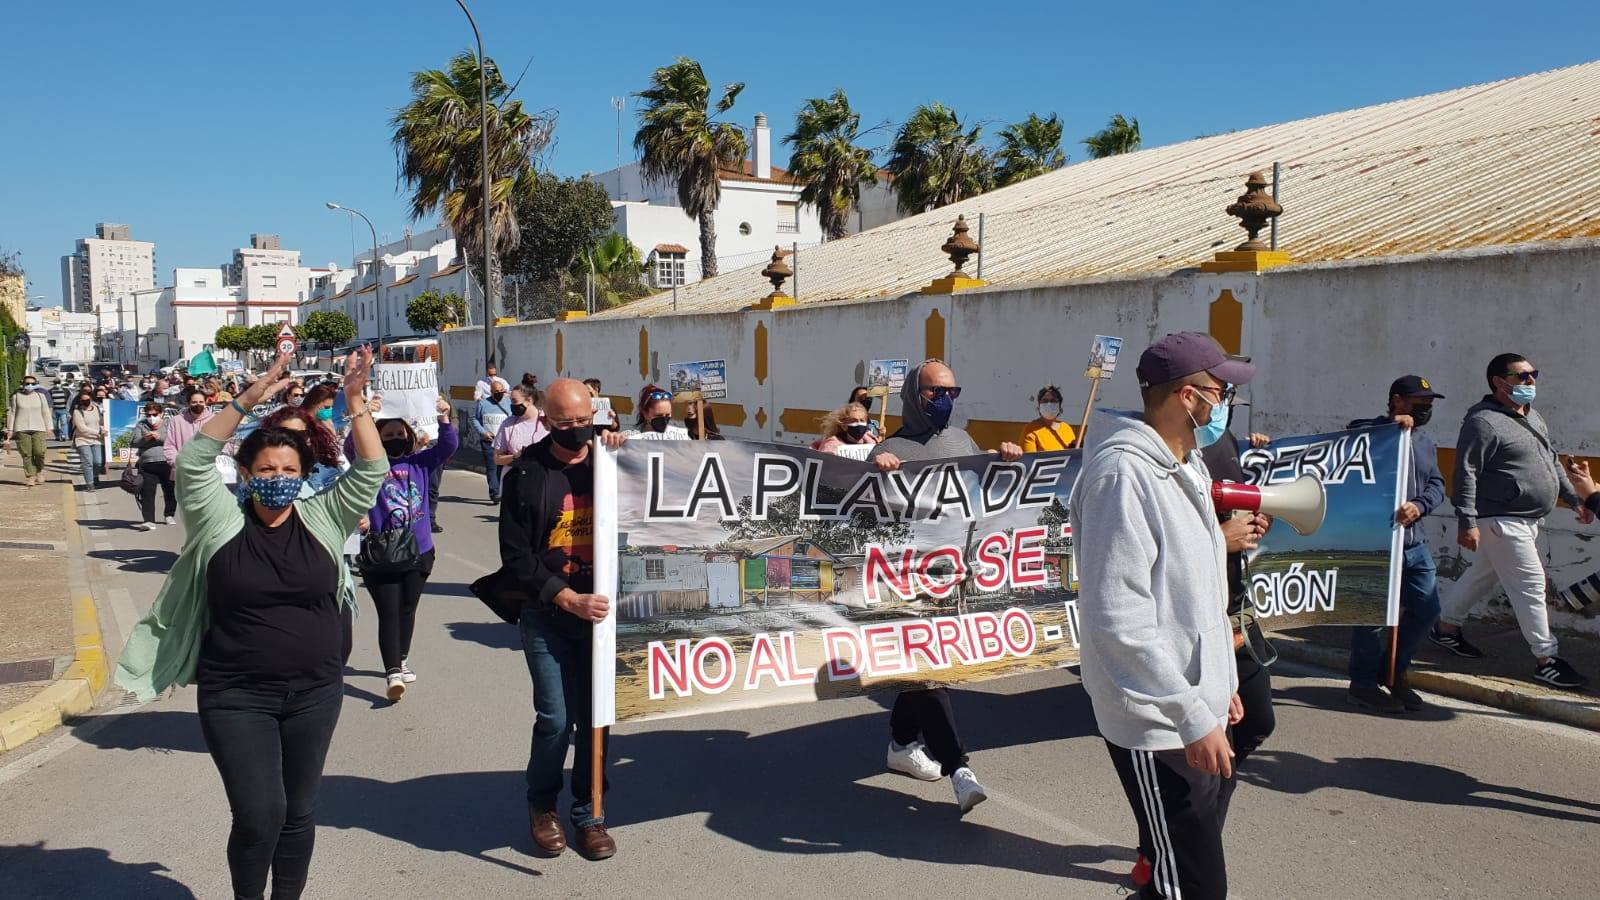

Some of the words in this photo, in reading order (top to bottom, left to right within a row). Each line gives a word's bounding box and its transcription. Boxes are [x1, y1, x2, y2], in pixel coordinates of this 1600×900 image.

[646, 453, 739, 522] LA
[751, 452, 976, 524] PLAYA
[980, 456, 1071, 518] DE
[863, 542, 967, 604] NO
[975, 524, 1049, 592] SE
[647, 637, 737, 700] NO
[744, 631, 817, 691] AL
[825, 607, 1036, 681] DERRIBO
[1251, 562, 1338, 618] CIÓN
